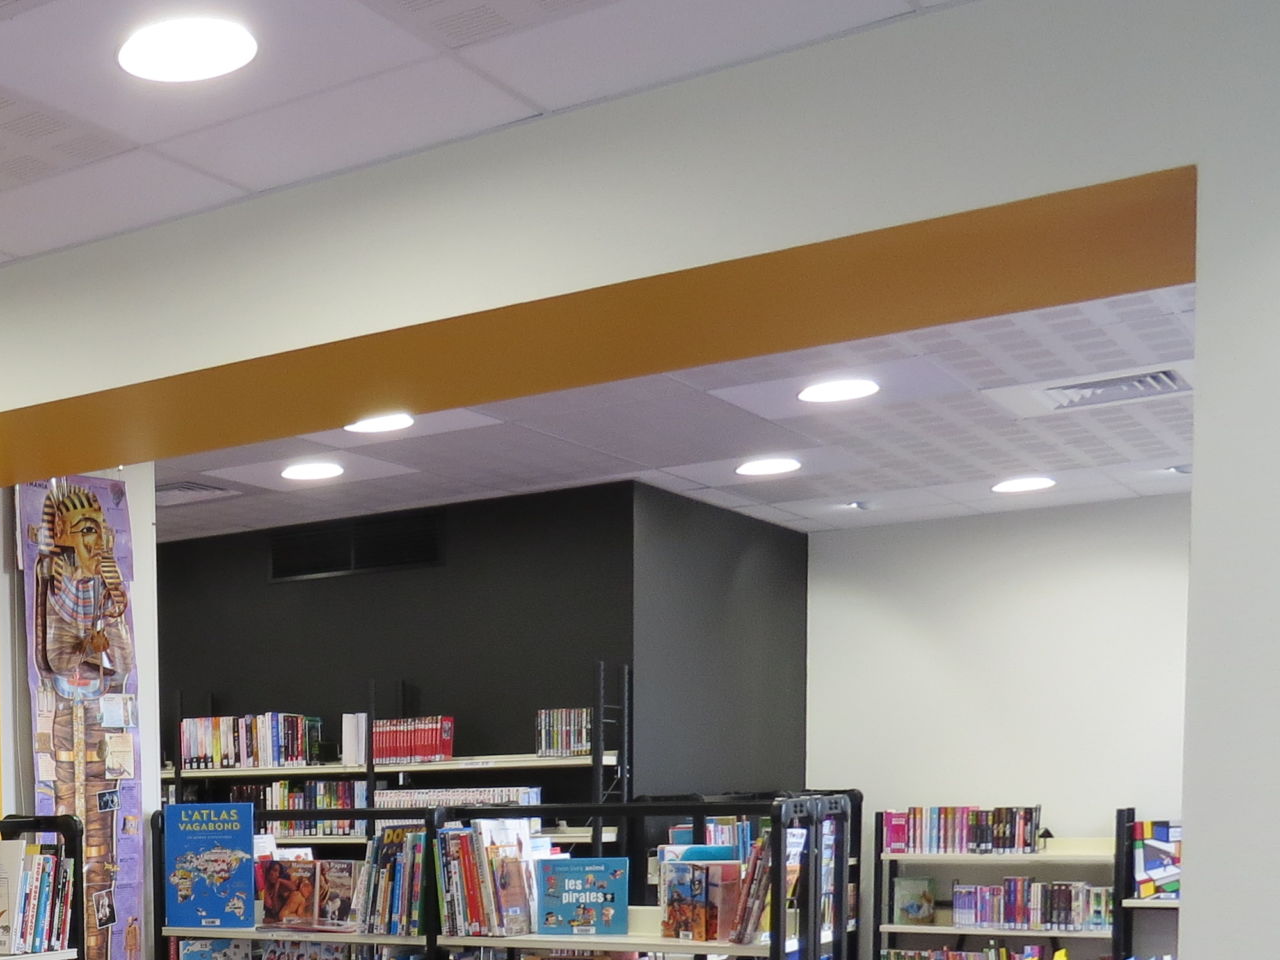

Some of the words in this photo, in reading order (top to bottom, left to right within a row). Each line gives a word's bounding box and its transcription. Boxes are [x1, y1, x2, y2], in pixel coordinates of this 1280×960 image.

[181, 808, 239, 821] L'ATLAS
[178, 821, 241, 832] VAGABOND
[33, 860, 42, 882] BOIS
[564, 878, 583, 891] les
[31, 883, 39, 901] DES
[562, 890, 605, 904] pirates
[26, 902, 37, 936] COPAIN
